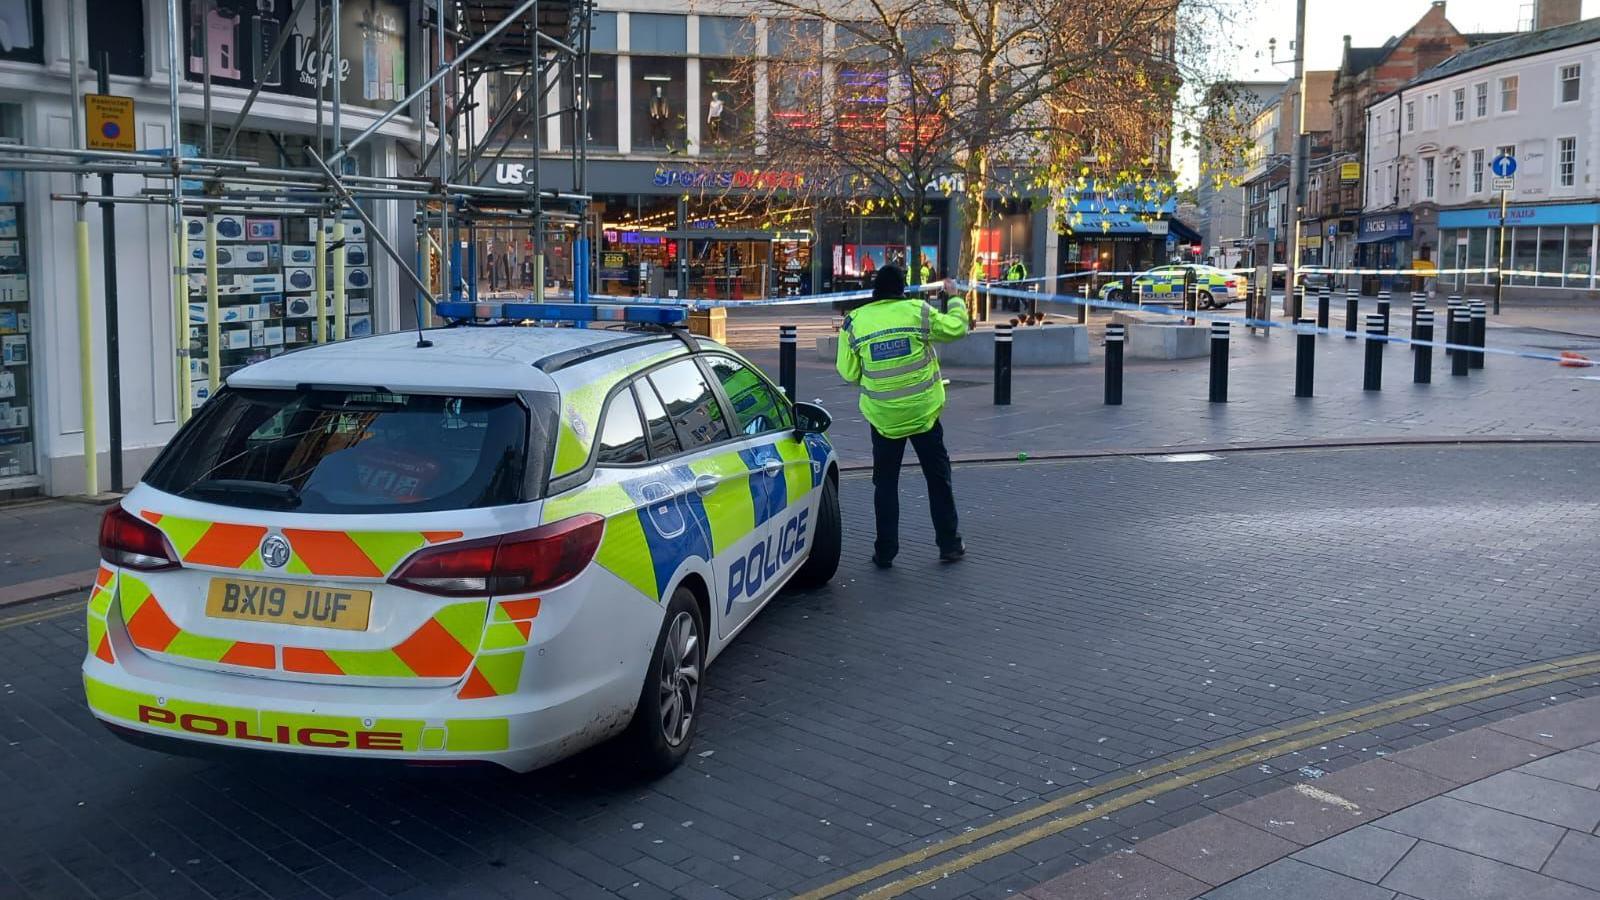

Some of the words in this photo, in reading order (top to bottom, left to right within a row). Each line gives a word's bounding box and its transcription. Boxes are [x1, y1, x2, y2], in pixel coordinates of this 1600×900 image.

[873, 340, 908, 353] POLICE
[724, 506, 810, 617] POLICE
[221, 583, 286, 616] BX19
[293, 590, 352, 623] JUF
[138, 704, 405, 751] POLICE
